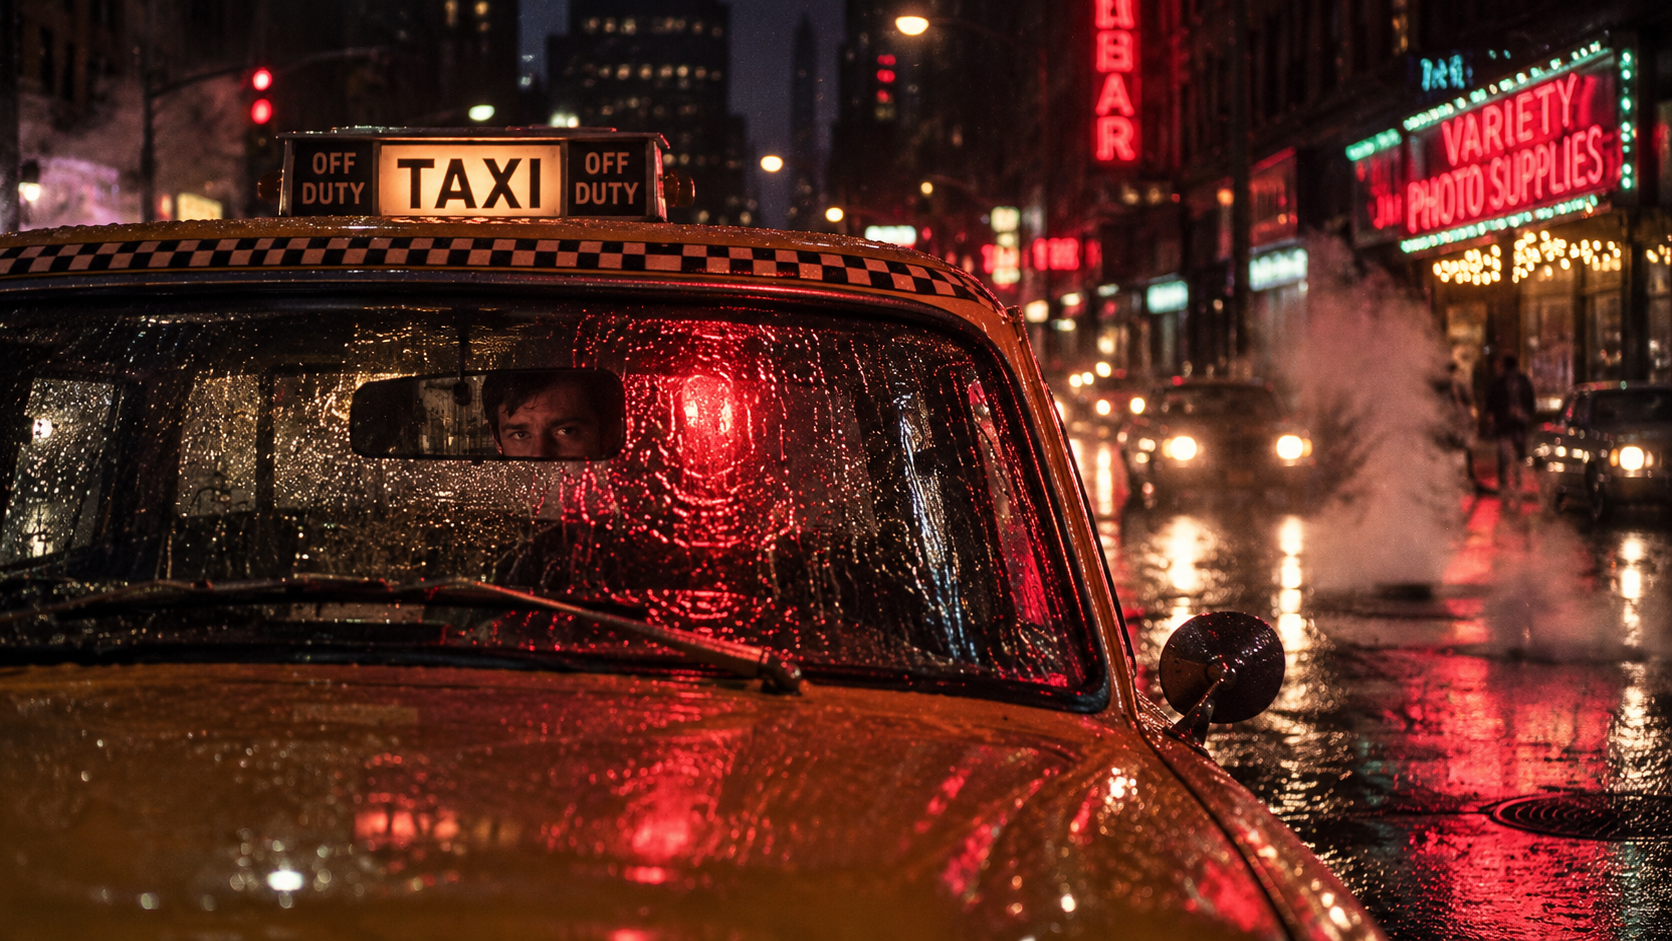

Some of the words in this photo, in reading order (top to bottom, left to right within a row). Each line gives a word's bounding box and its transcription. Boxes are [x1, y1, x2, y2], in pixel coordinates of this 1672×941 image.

[1441, 72, 1577, 166] VARIETY
[312, 152, 355, 174] OFF
[585, 152, 628, 174] OFF
[397, 158, 541, 209] TAXI
[1407, 164, 1484, 233] PHOTO
[1489, 124, 1603, 210] SUPPLIES
[302, 182, 365, 205] DUTY
[576, 182, 639, 205] DUTY
